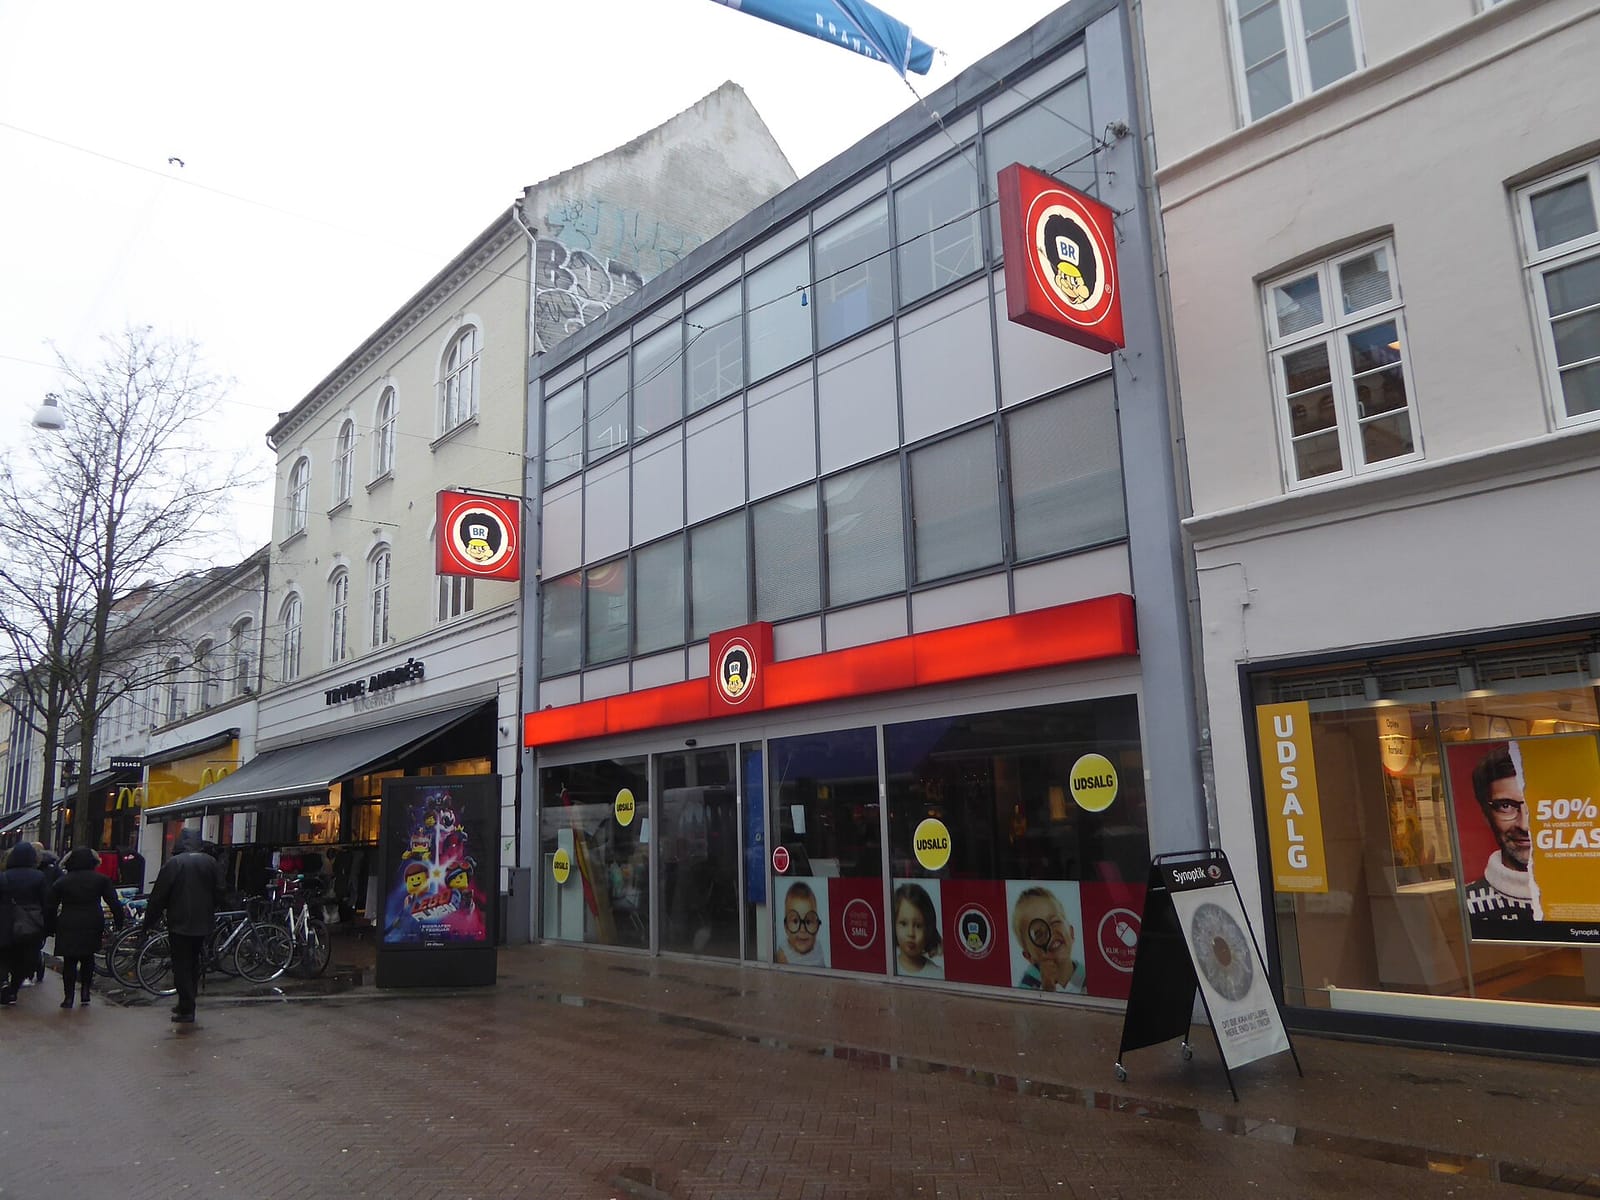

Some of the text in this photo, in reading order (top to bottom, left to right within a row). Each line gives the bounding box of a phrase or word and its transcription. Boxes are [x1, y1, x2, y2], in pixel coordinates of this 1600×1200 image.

[1060, 241, 1076, 260] BR
[472, 527, 485, 537] BR
[1073, 774, 1114, 791] UDSALG
[1273, 714, 1309, 869] UDSALG
[616, 802, 633, 812] UDSALG
[1536, 797, 1598, 821] 50%
[916, 838, 947, 851] UDSALG
[1173, 867, 1206, 885] Synoptik
[851, 927, 868, 937] SMIL
[1570, 928, 1600, 937] Synoptik
